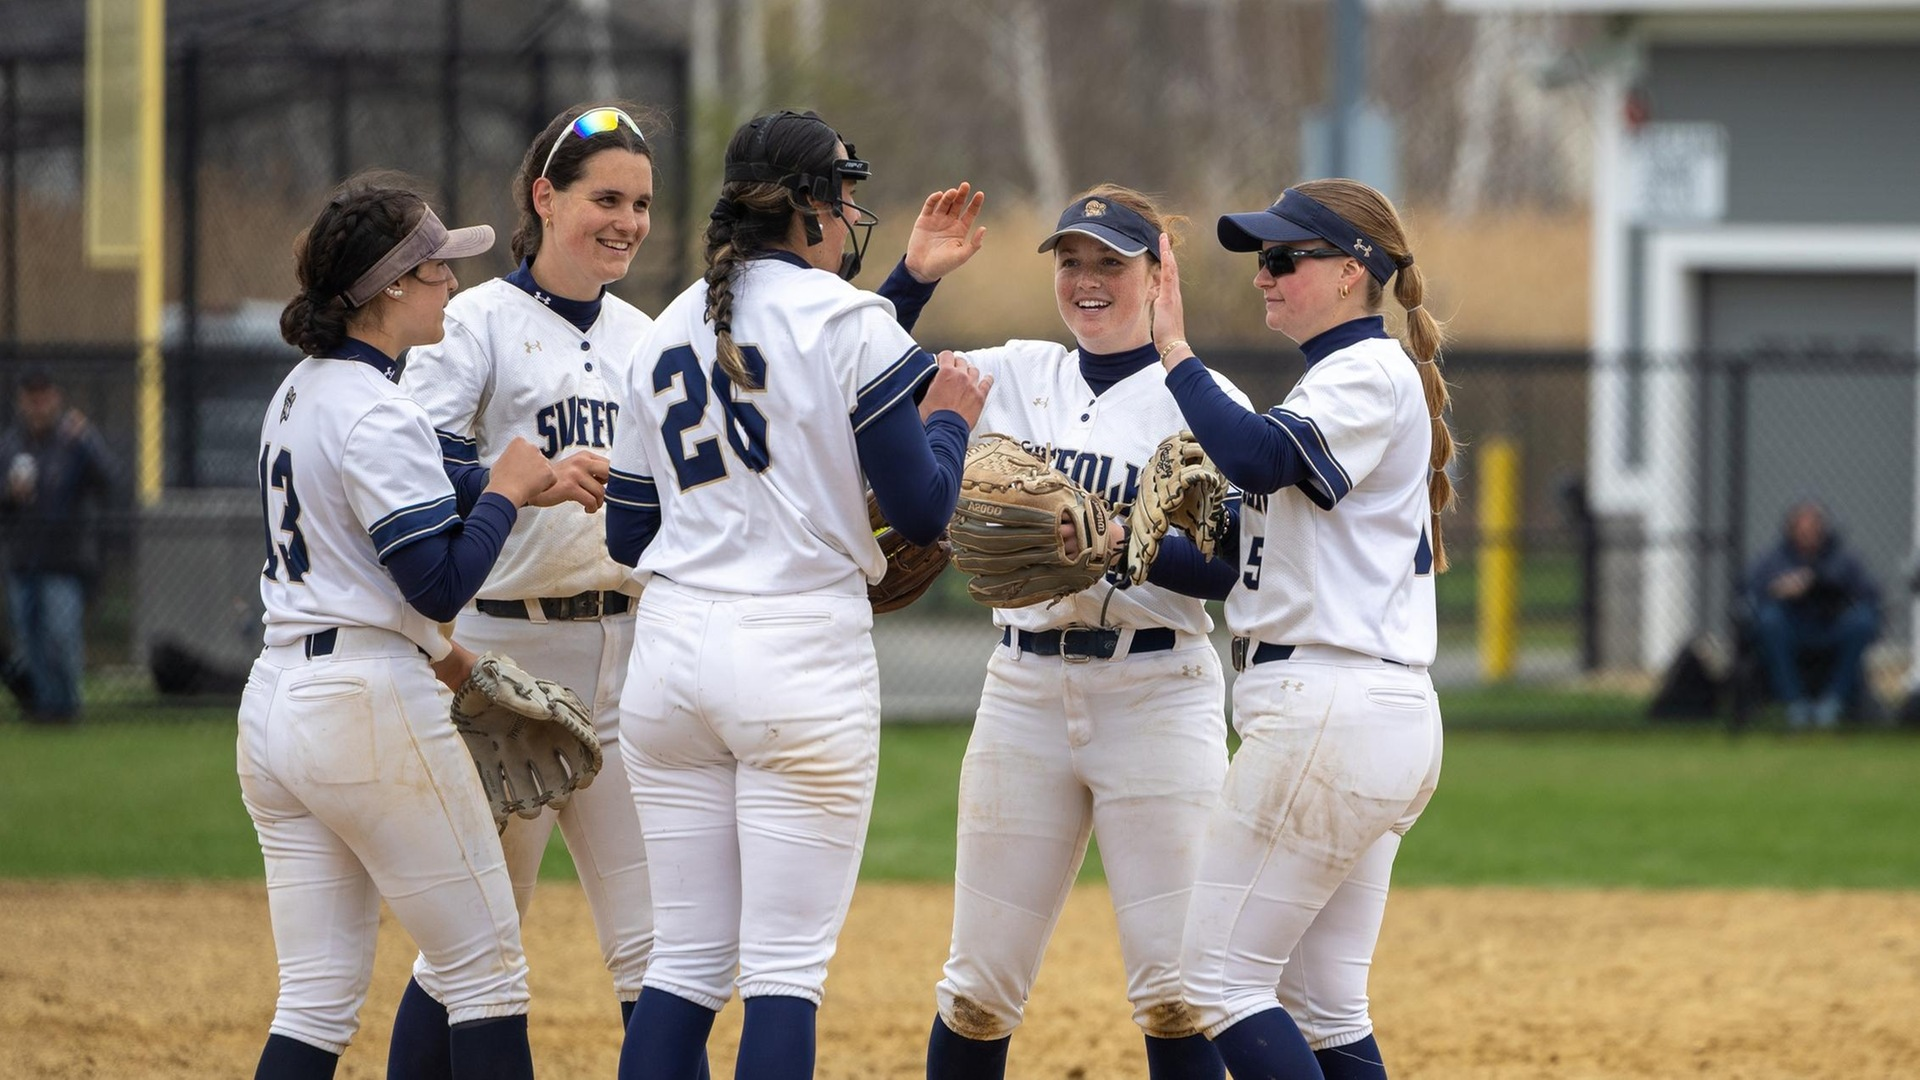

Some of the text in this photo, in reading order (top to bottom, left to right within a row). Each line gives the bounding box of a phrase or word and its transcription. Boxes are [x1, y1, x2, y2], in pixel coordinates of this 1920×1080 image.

[652, 341, 771, 494] 26
[261, 441, 311, 586] 13
[967, 501, 1003, 516] A2000
[1026, 445, 1141, 517] FOLK
